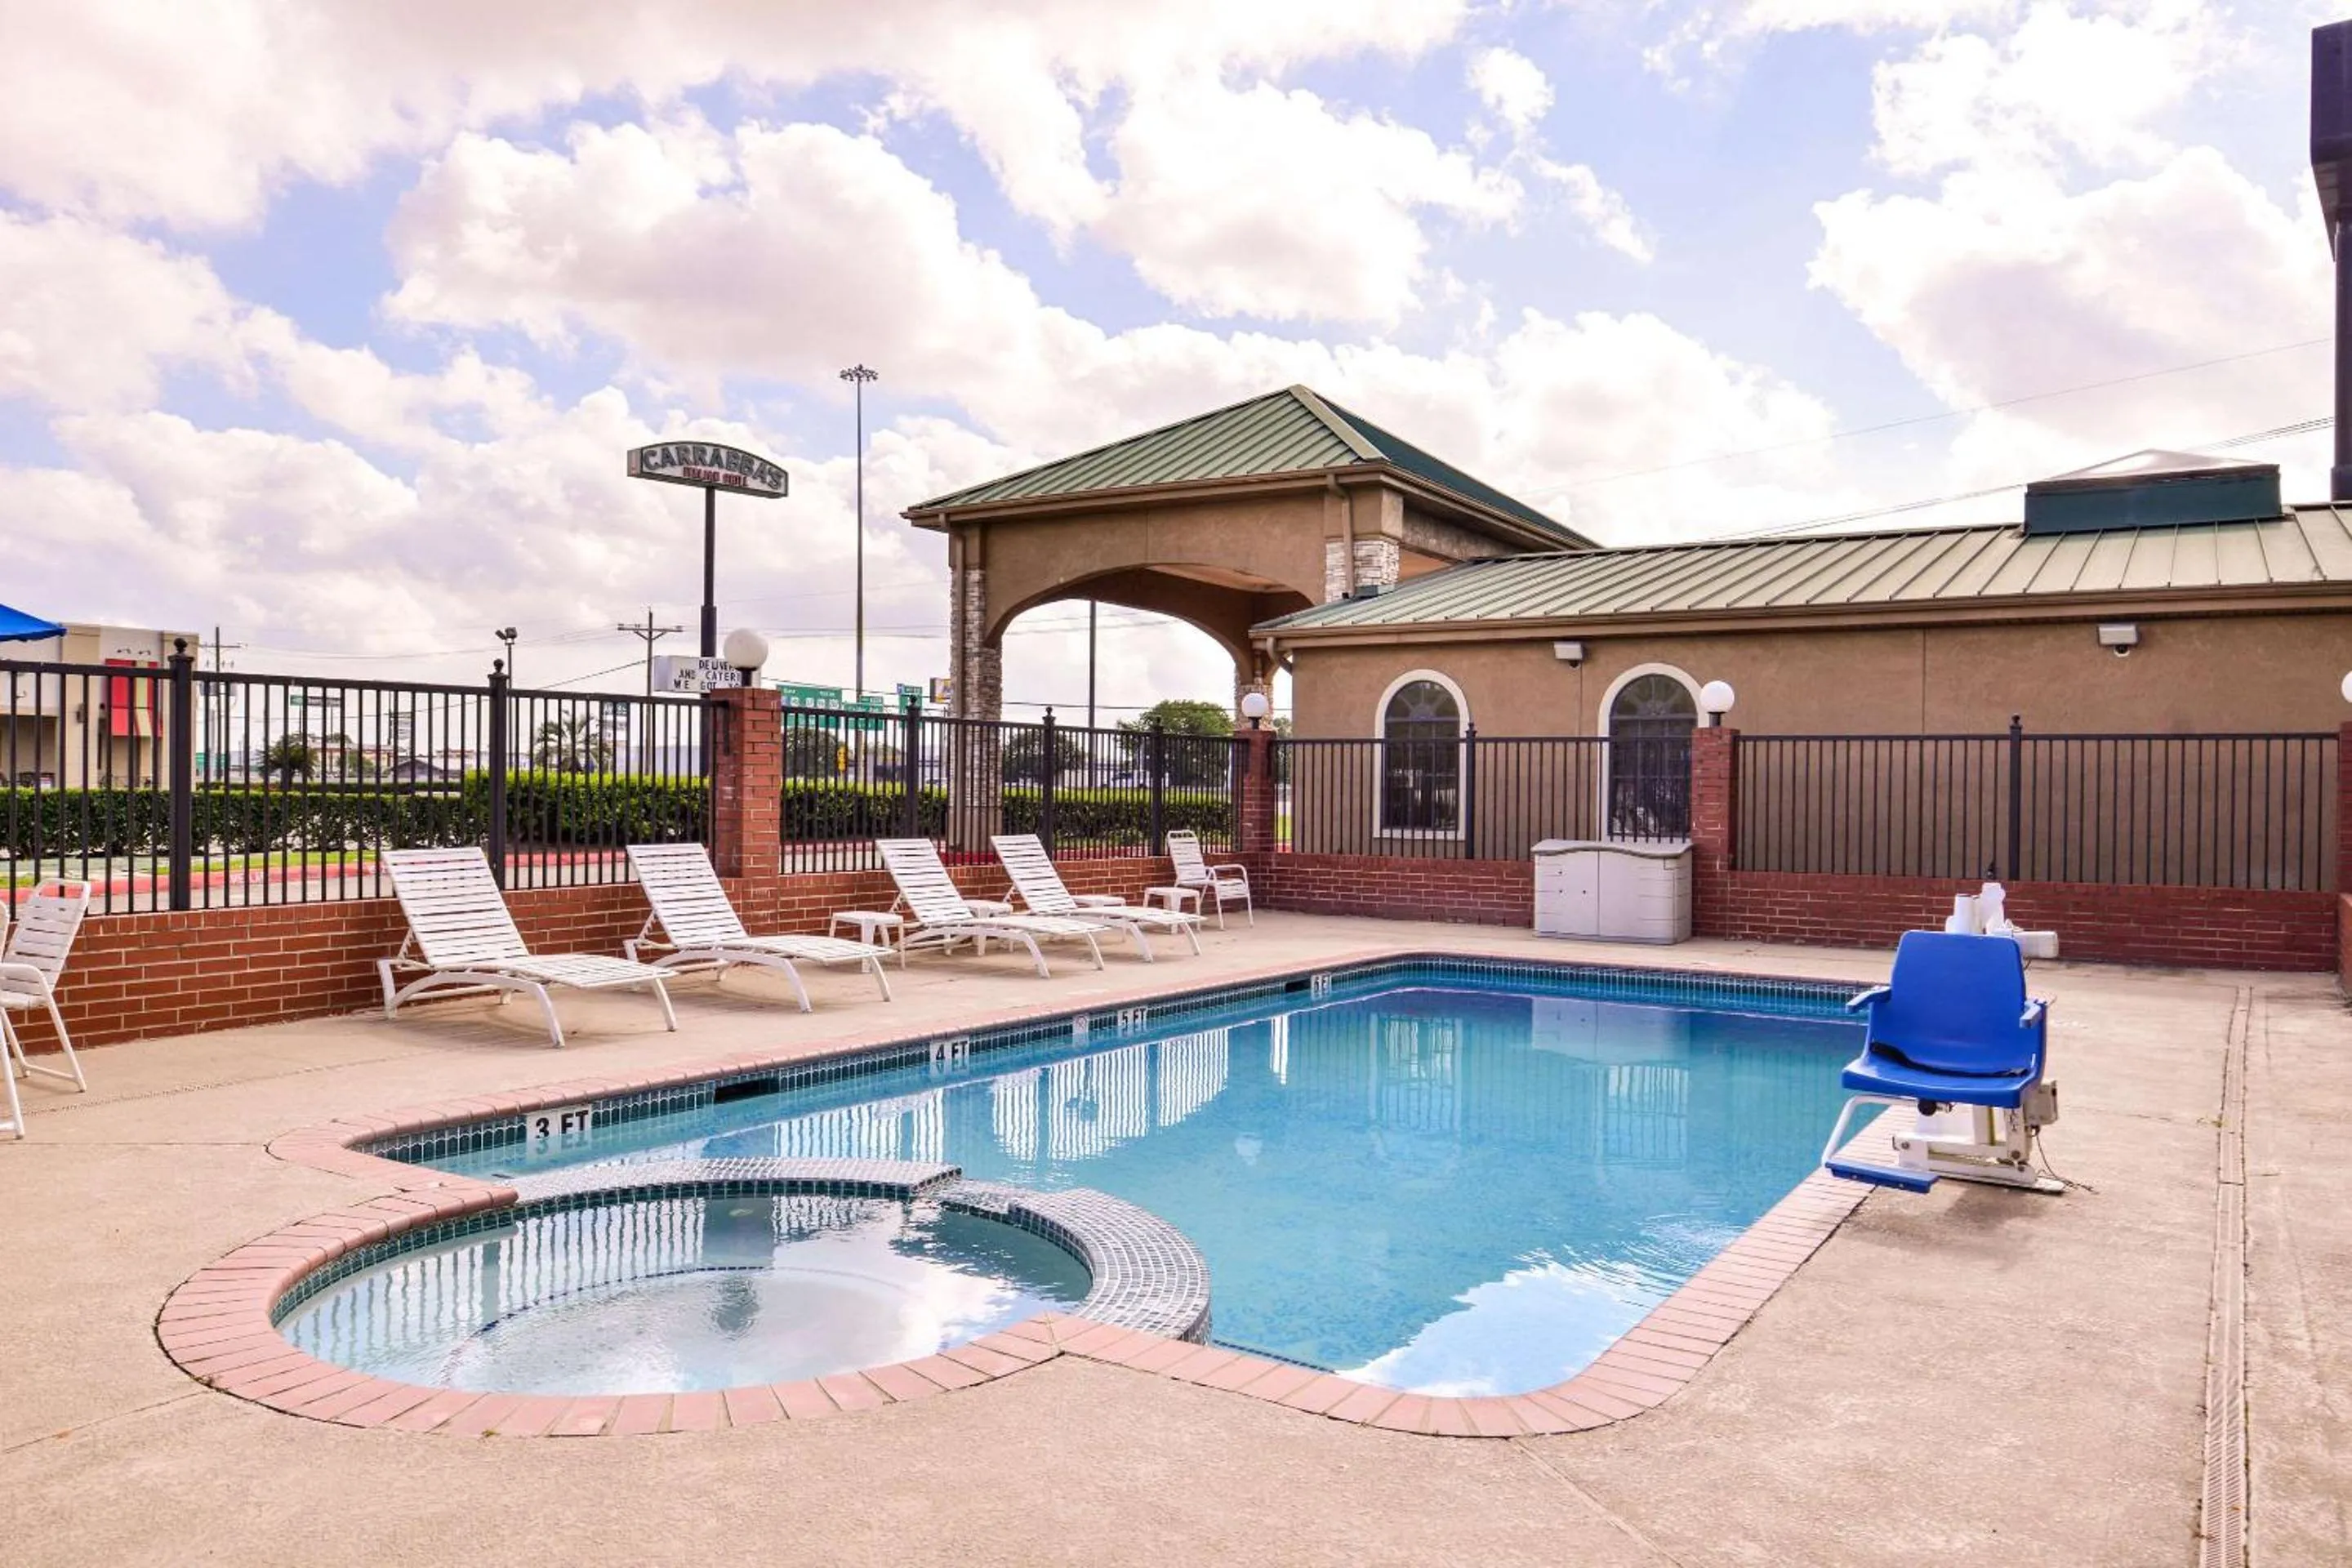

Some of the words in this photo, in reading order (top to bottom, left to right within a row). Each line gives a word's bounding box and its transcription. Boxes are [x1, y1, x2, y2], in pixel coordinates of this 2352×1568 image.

[679, 669, 696, 679] AND
[674, 679, 689, 689] WE
[701, 681, 717, 691] GOT
[1122, 1011, 1129, 1023] 5
[1133, 1008, 1147, 1021] FT
[936, 1045, 946, 1060] 4
[951, 1040, 968, 1058] FT
[535, 1117, 550, 1139] 3
[561, 1110, 588, 1134] FT
